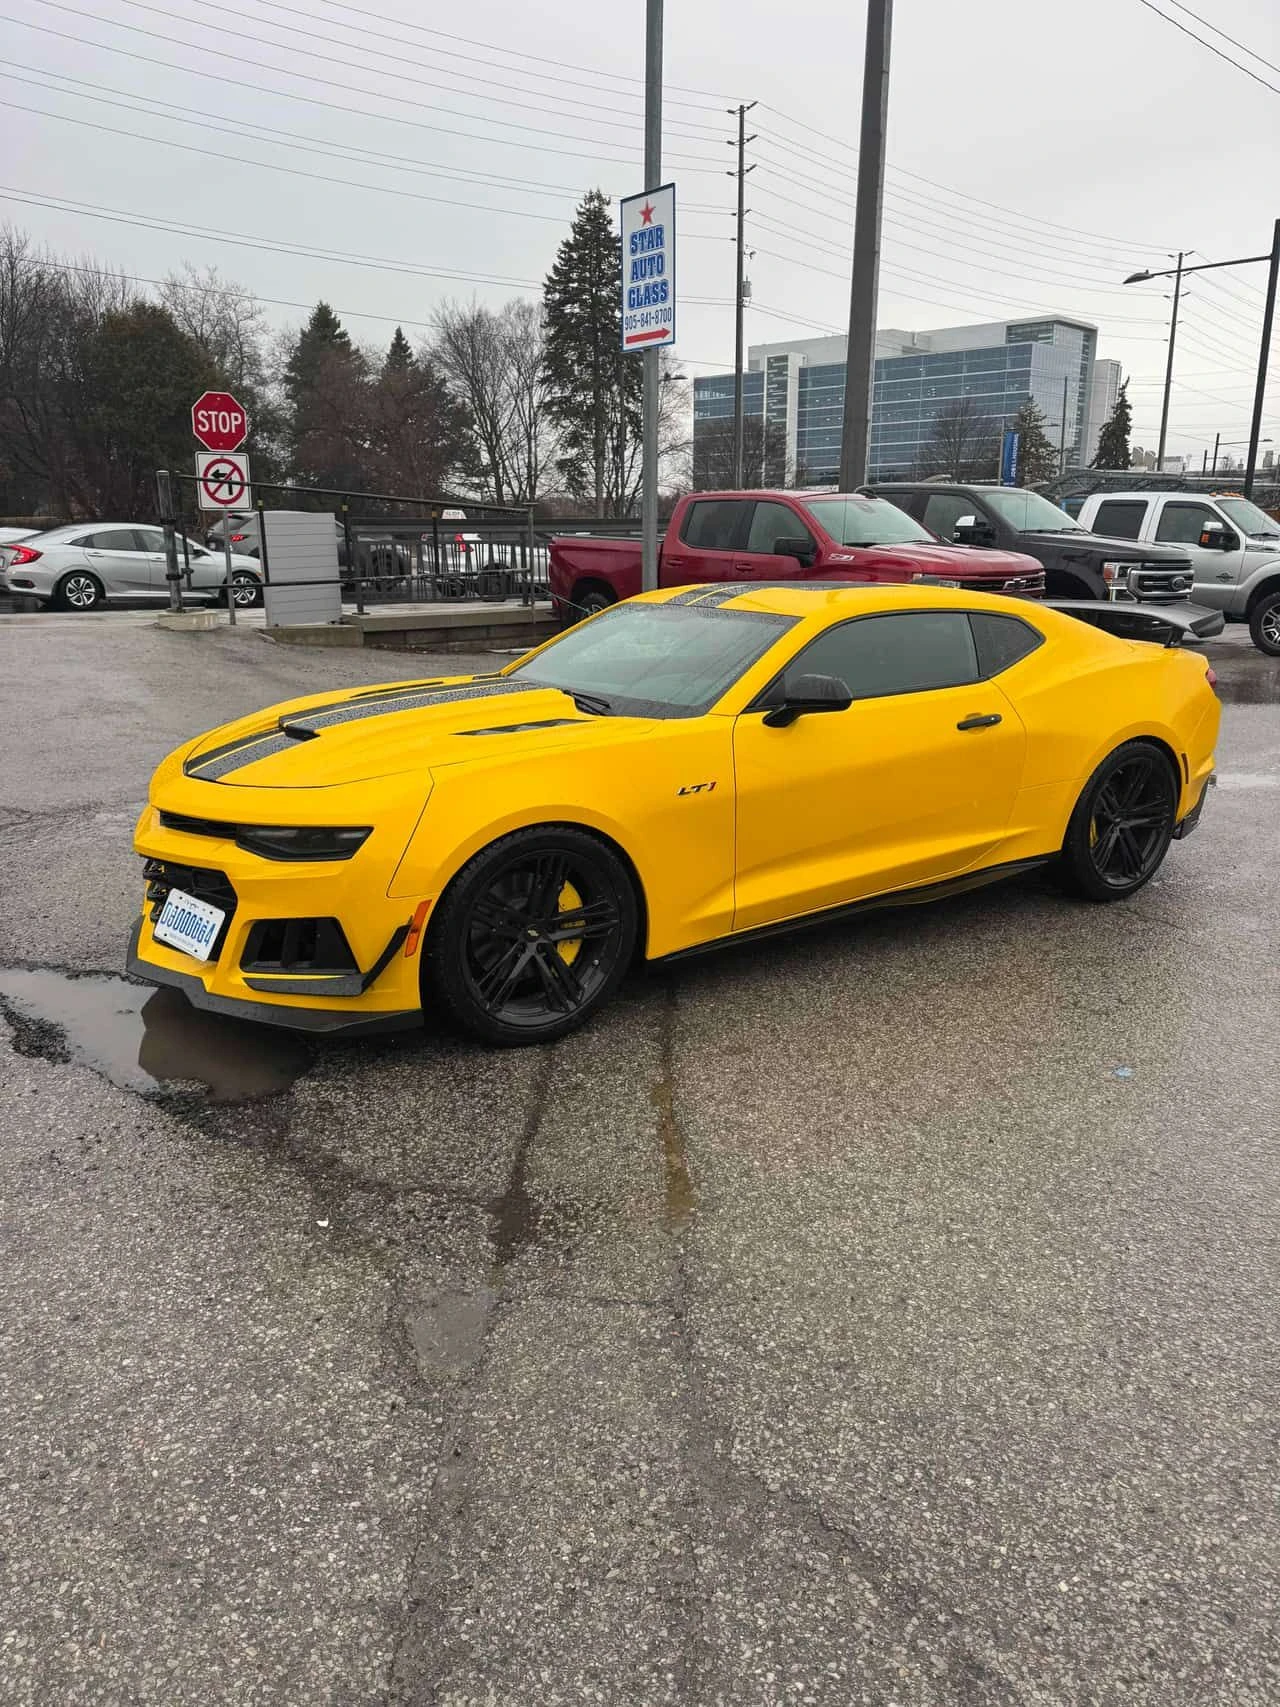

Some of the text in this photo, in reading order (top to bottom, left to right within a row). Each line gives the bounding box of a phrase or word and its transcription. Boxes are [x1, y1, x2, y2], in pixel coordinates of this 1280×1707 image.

[630, 224, 665, 256] STAR
[630, 251, 665, 283] AUTO
[628, 279, 669, 311] GLASS
[625, 307, 672, 331] 905-841-8700
[198, 410, 242, 433] STOP
[678, 781, 717, 796] LT1
